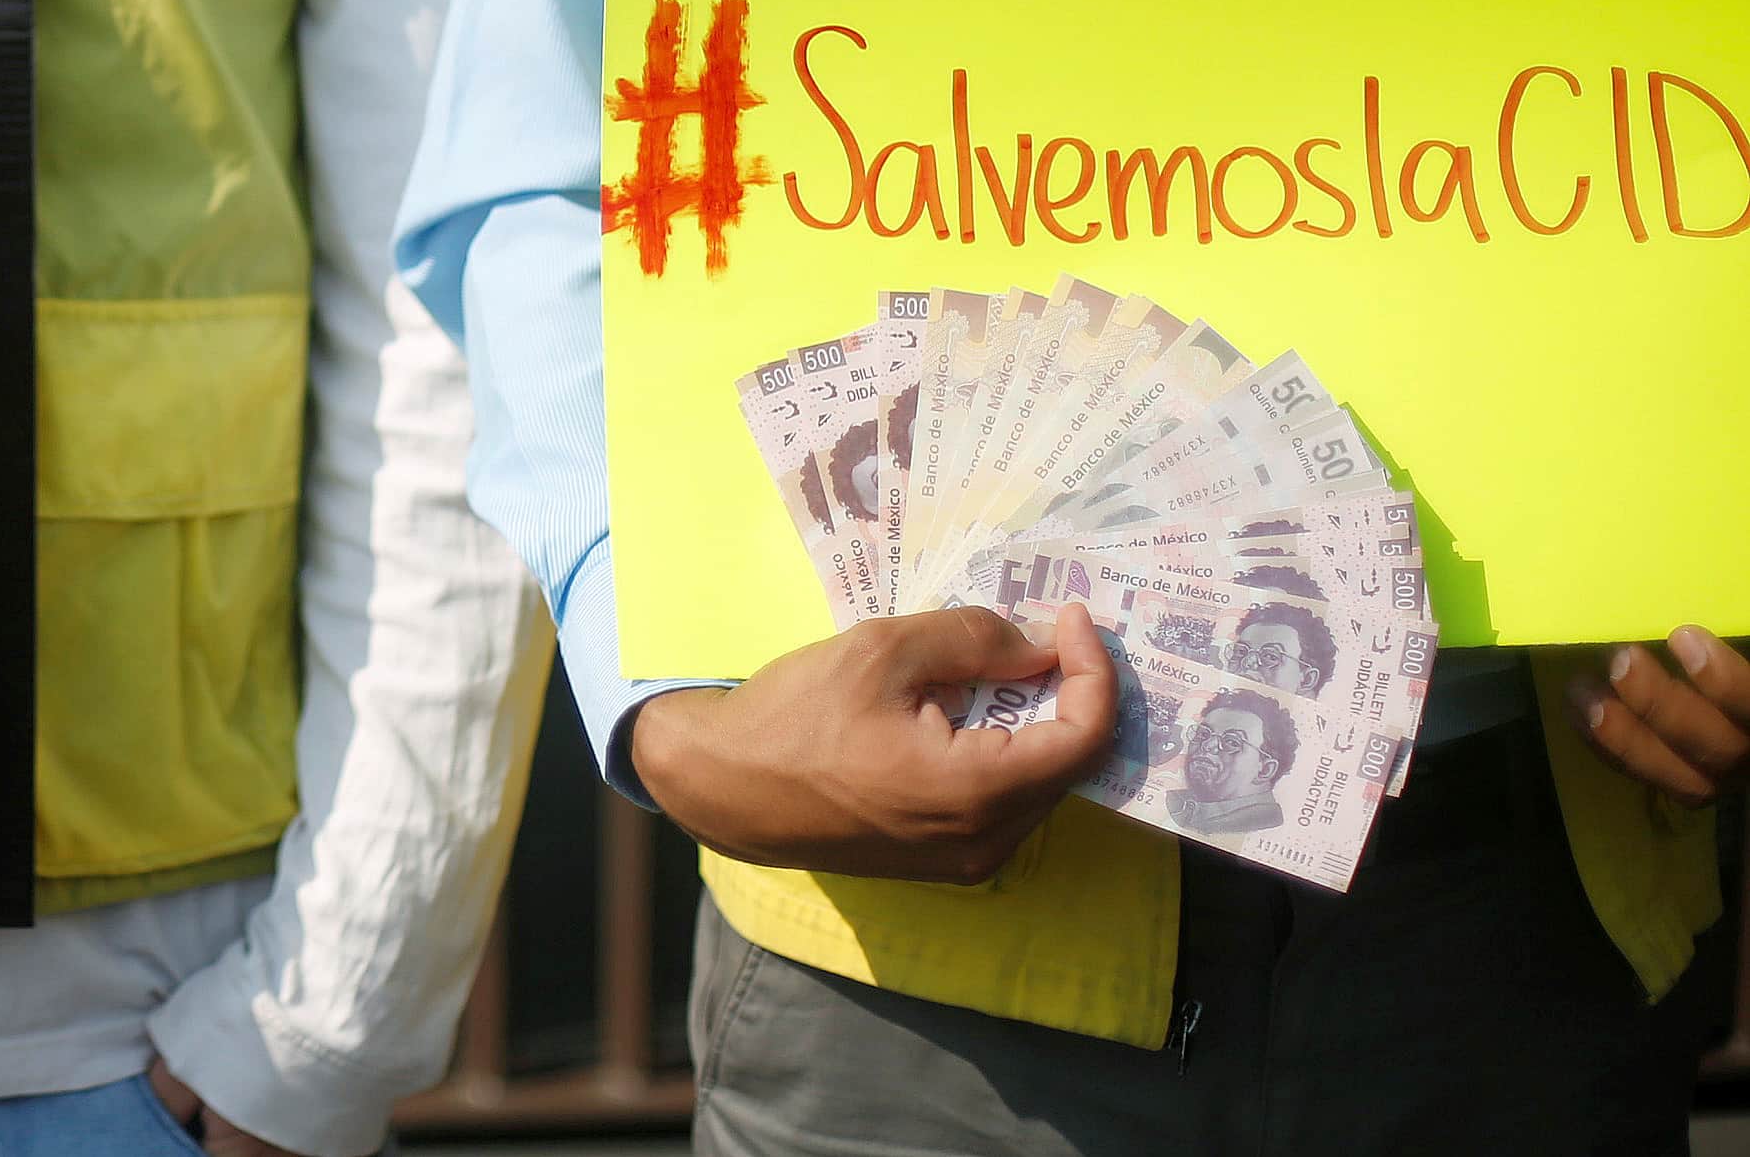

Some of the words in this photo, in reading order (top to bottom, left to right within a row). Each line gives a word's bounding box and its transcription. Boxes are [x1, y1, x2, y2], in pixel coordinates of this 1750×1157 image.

[893, 296, 930, 318] 500
[804, 345, 842, 372] 500
[930, 354, 950, 413] México
[987, 353, 1016, 410] México
[981, 415, 996, 436] de
[993, 422, 1025, 473] Banco
[1018, 398, 1036, 419] de
[1027, 339, 1060, 395] México
[1034, 433, 1073, 480] Banco
[1070, 411, 1089, 432] de
[1083, 359, 1126, 411] México
[928, 418, 943, 440] de
[1061, 447, 1104, 490] Banco
[1103, 427, 1123, 448] de
[1118, 382, 1166, 430] México
[921, 444, 940, 498] Banco
[887, 488, 901, 541] México
[850, 539, 874, 592] México
[887, 546, 901, 564] de
[1100, 565, 1148, 588] Banco
[1152, 578, 1171, 592] de
[1176, 582, 1231, 604] México
[1394, 572, 1416, 611] 500
[866, 595, 880, 615] de
[1125, 651, 1144, 666] de
[1147, 657, 1201, 685] México
[1402, 635, 1429, 675] 500
[1360, 738, 1390, 778] 500
[1297, 755, 1333, 828] DIDÁCTICO
[1318, 771, 1348, 826] BILLETE
